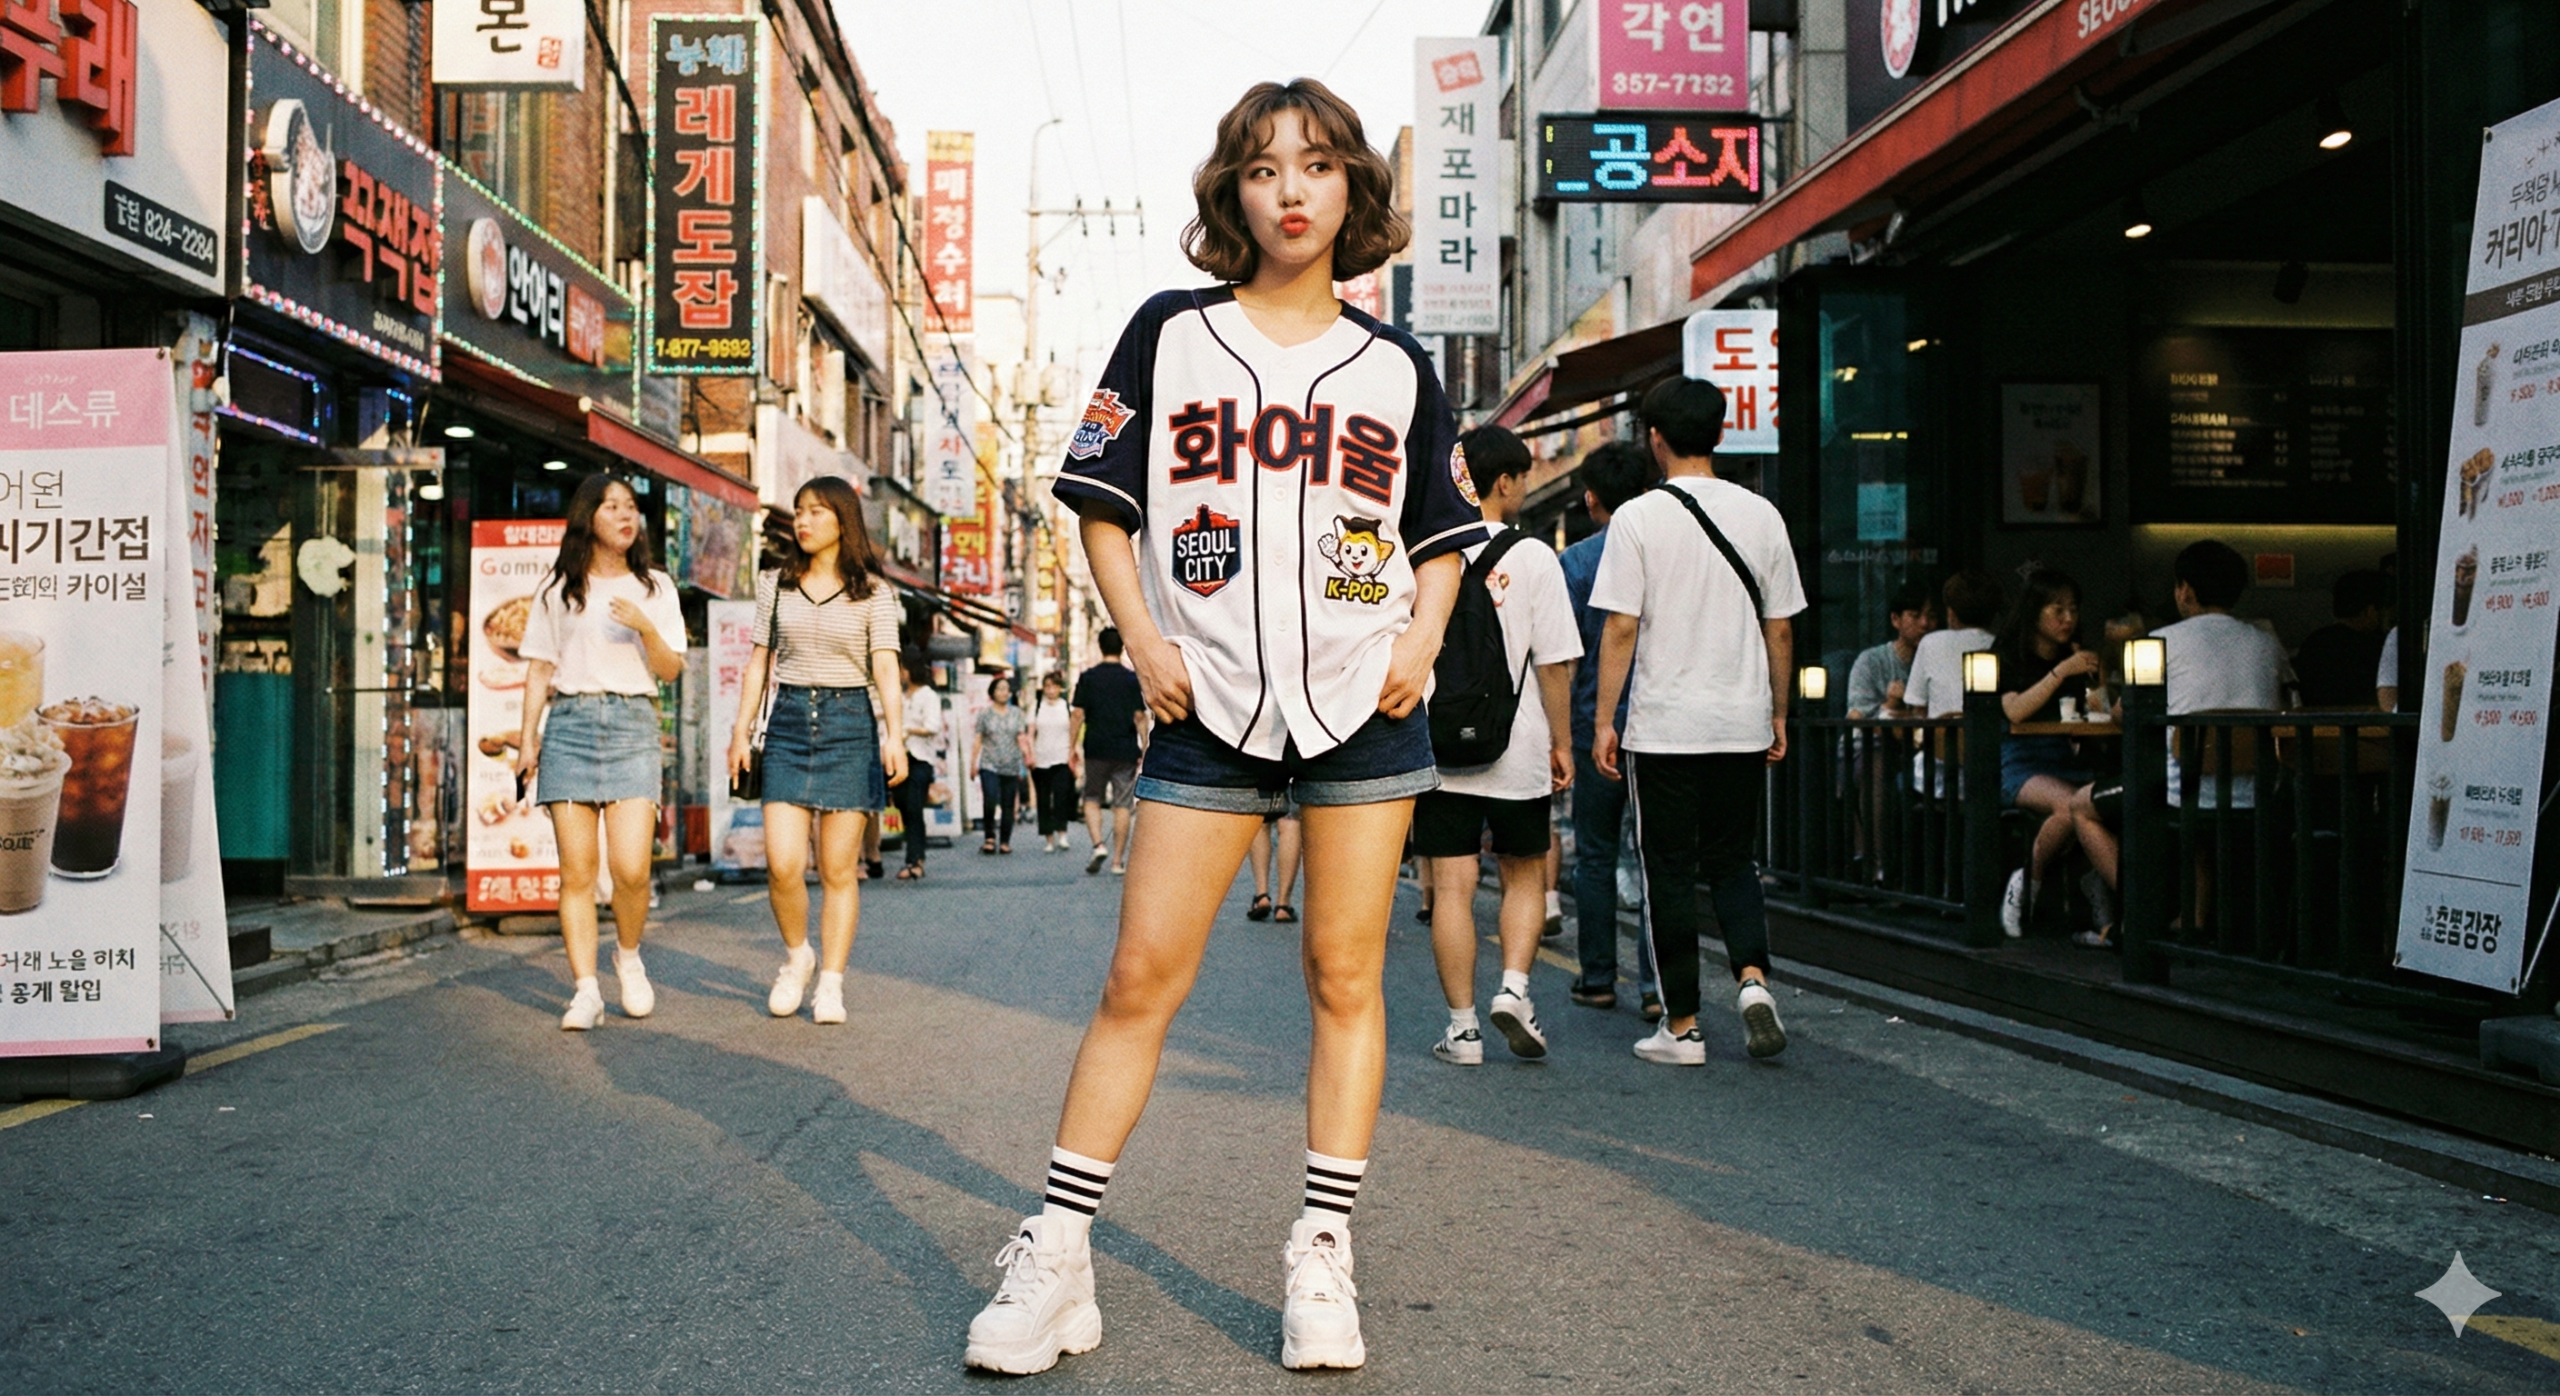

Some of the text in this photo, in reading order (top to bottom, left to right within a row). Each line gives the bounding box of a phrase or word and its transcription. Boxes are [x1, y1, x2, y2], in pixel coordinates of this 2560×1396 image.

[1439, 103, 1477, 273] 재포마라
[672, 84, 738, 328] 레게도잡
[1176, 532, 1236, 560] SEOUL
[1184, 556, 1228, 582] CITY
[1325, 577, 1389, 605] K-POP
